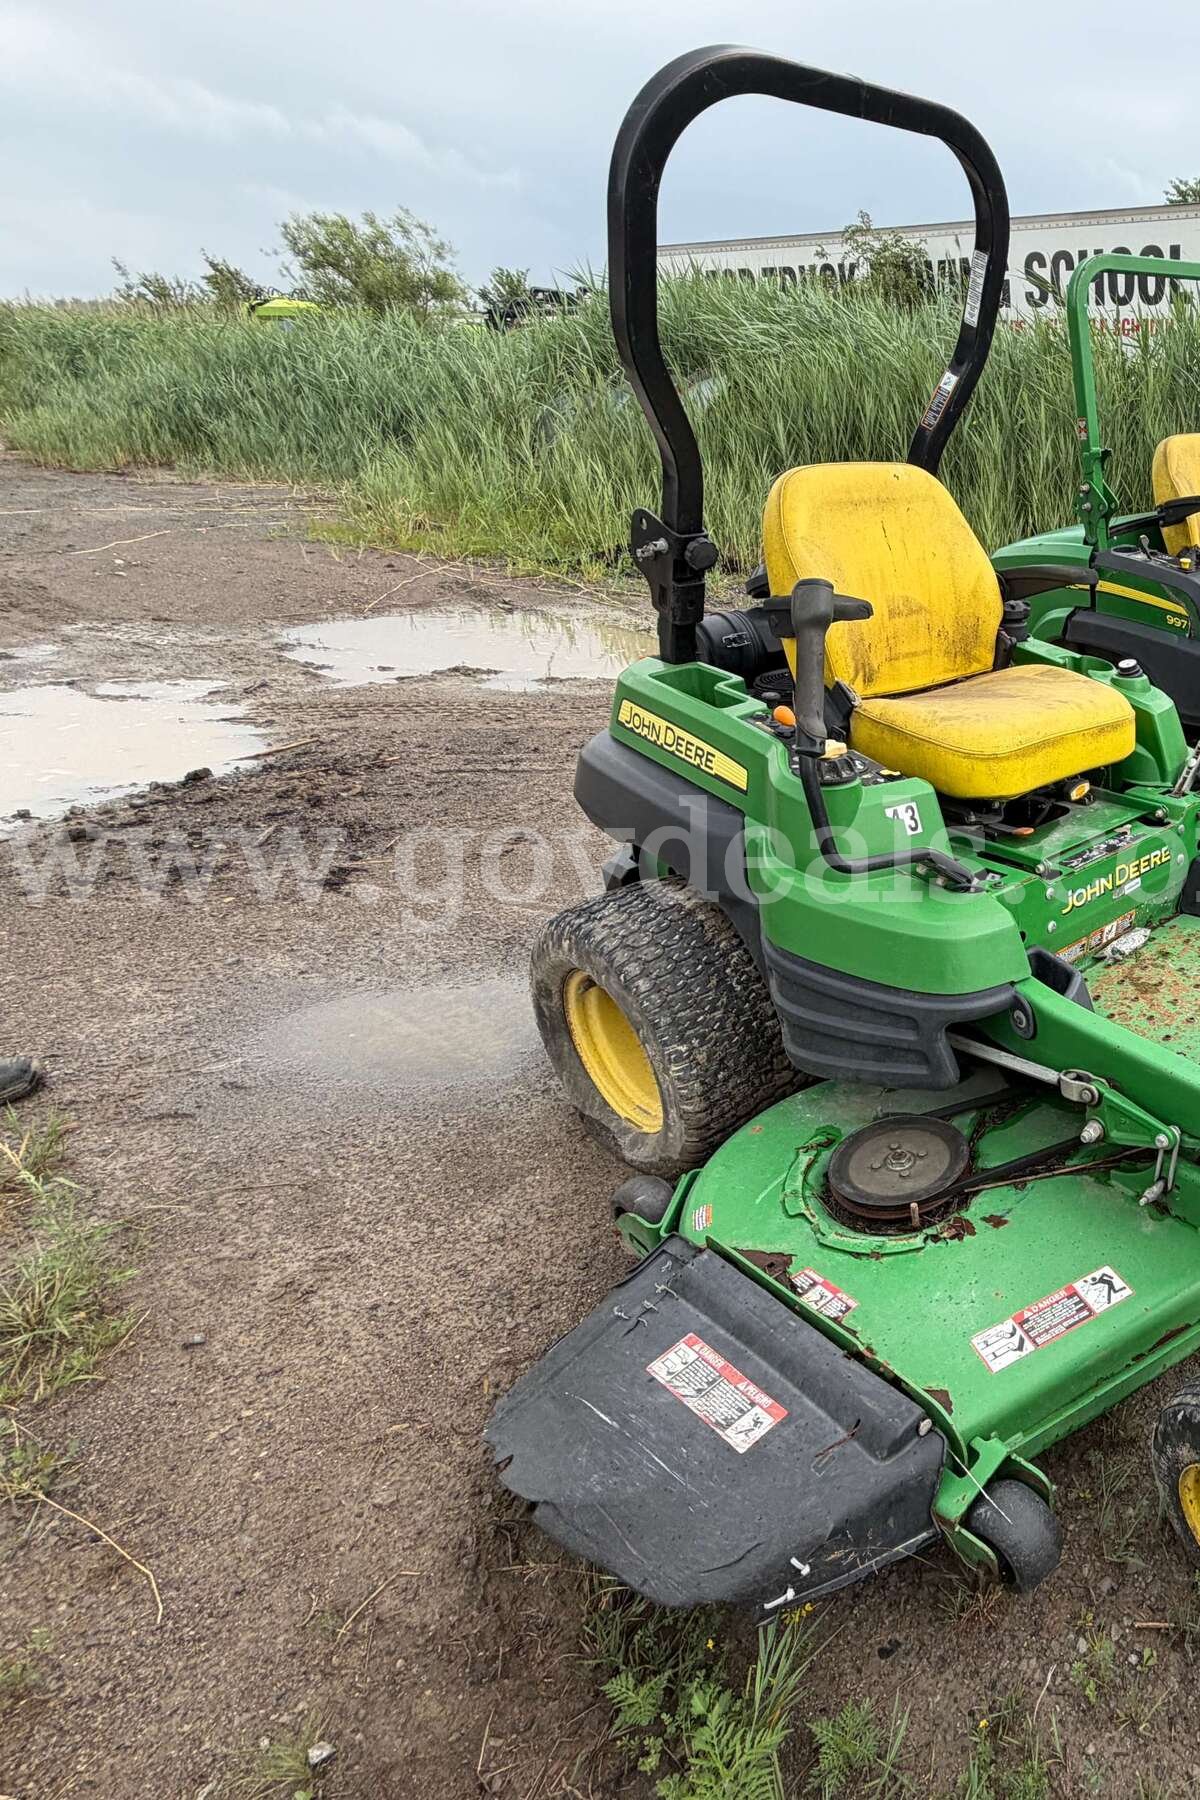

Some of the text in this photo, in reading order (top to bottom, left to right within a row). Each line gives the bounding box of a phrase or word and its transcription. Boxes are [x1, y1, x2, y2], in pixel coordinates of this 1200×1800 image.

[1166, 614, 1188, 630] 997
[625, 705, 717, 772] JOHN DEERE
[1061, 873, 1113, 915] JOHN
[1115, 845, 1172, 888] DEERE
[1031, 1290, 1067, 1313] DANGER
